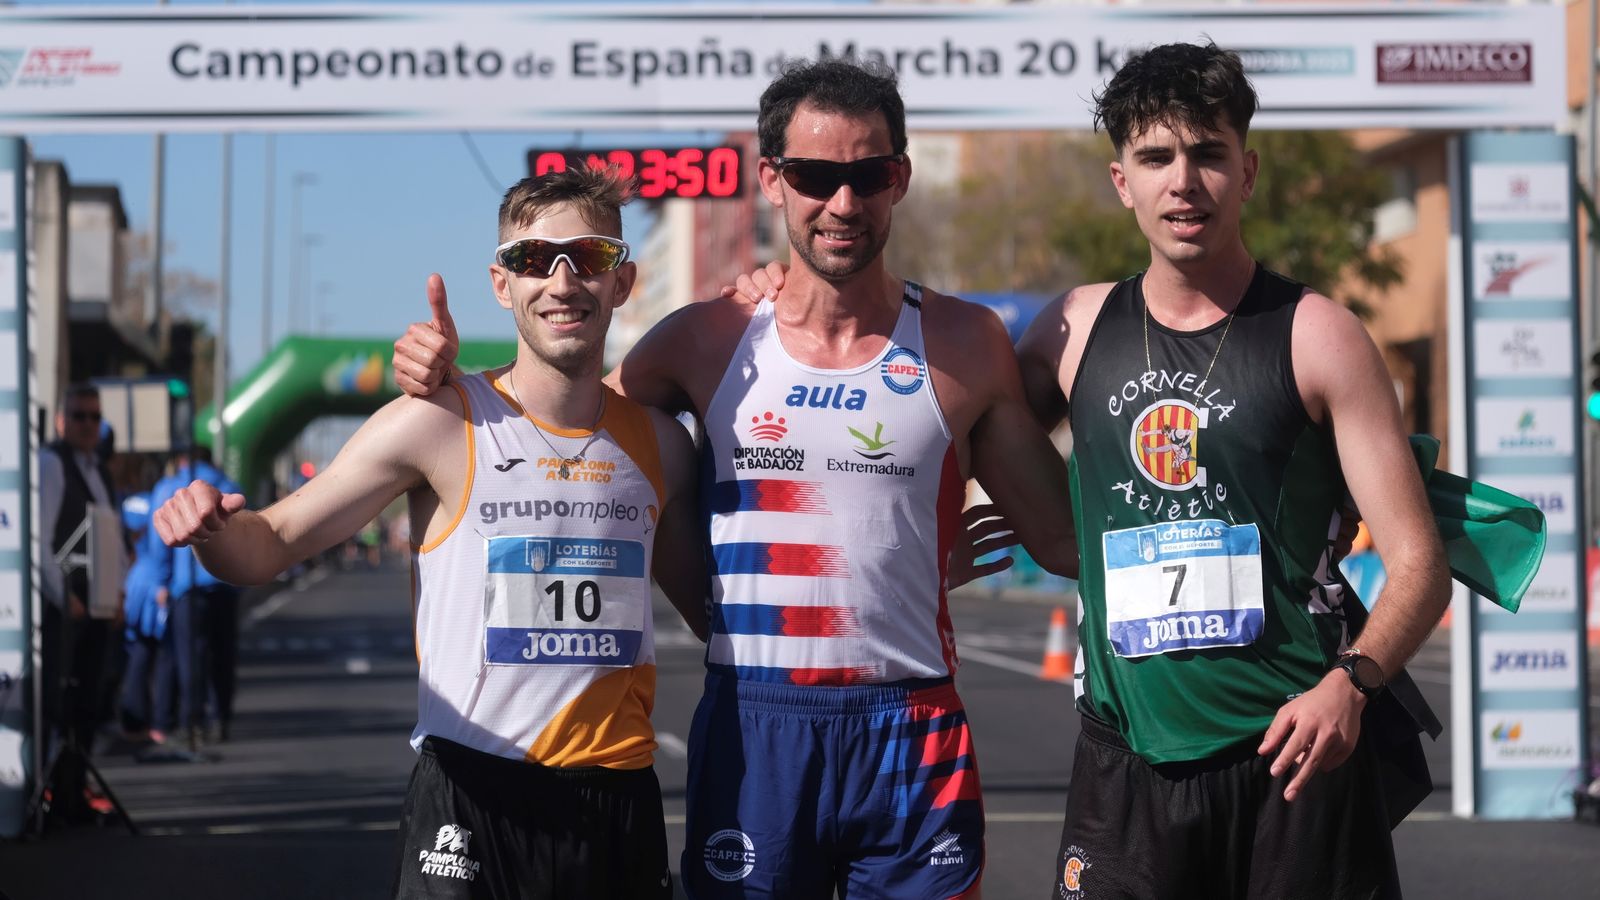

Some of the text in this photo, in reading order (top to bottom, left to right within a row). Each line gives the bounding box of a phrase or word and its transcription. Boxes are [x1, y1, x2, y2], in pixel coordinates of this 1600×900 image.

[170, 42, 504, 88] Campeonato
[513, 50, 555, 76] de
[571, 36, 754, 85] España
[1017, 41, 1079, 77] 20
[1414, 44, 1528, 71] IMDECO
[888, 364, 919, 377] CAPEX
[785, 383, 867, 411] aula
[734, 445, 804, 461] DIPUTACIÓN
[735, 458, 805, 471] DE BADAJOZ
[827, 458, 915, 477] Extremadura
[480, 498, 638, 524] grupompleo
[1158, 525, 1222, 542] LOTERÍAS
[556, 543, 618, 557] LOTERÍAS
[1162, 563, 1187, 607] 7
[545, 579, 602, 622] 10
[418, 849, 480, 873] PAMPLONA
[710, 849, 748, 862] CAPEX
[421, 861, 475, 881] ATLETICO
